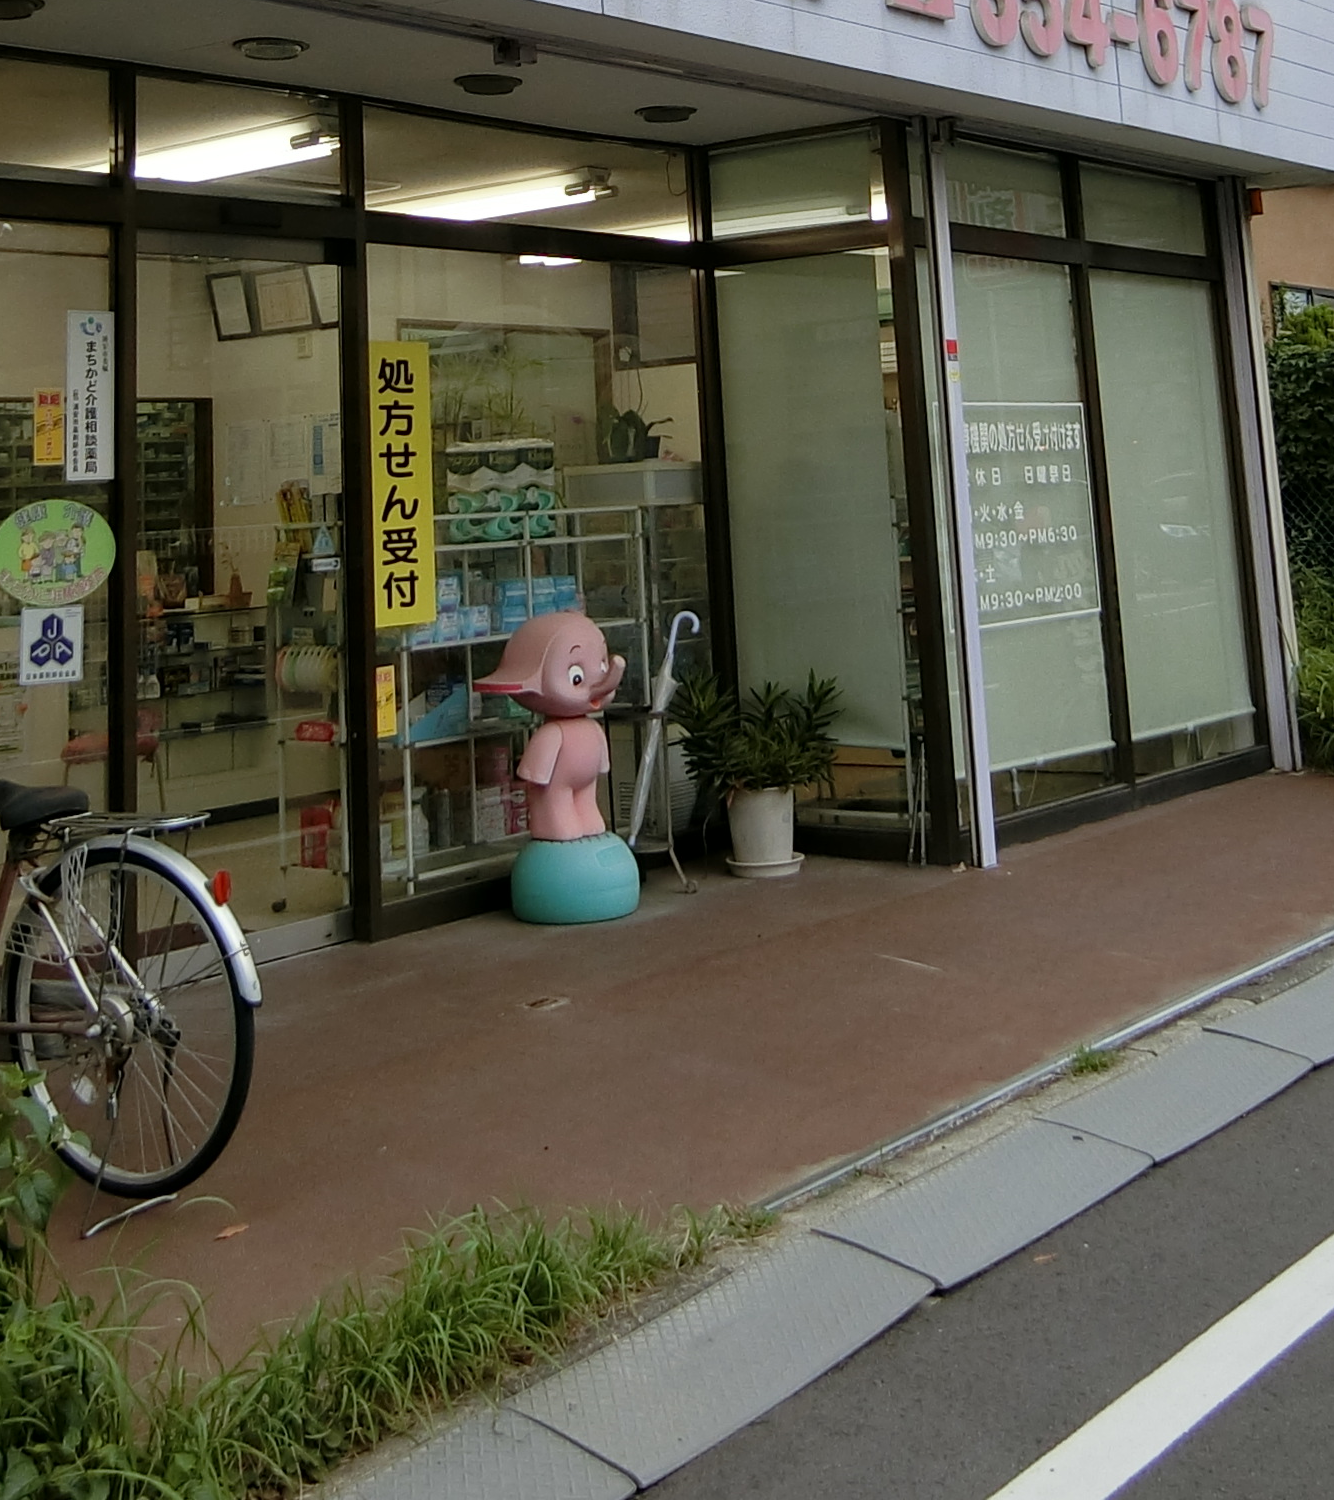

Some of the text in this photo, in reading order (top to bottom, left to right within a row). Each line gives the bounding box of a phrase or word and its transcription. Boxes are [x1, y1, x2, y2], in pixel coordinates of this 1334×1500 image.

[377, 356, 420, 610] 処方せん受付
[967, 466, 1002, 487] 休日
